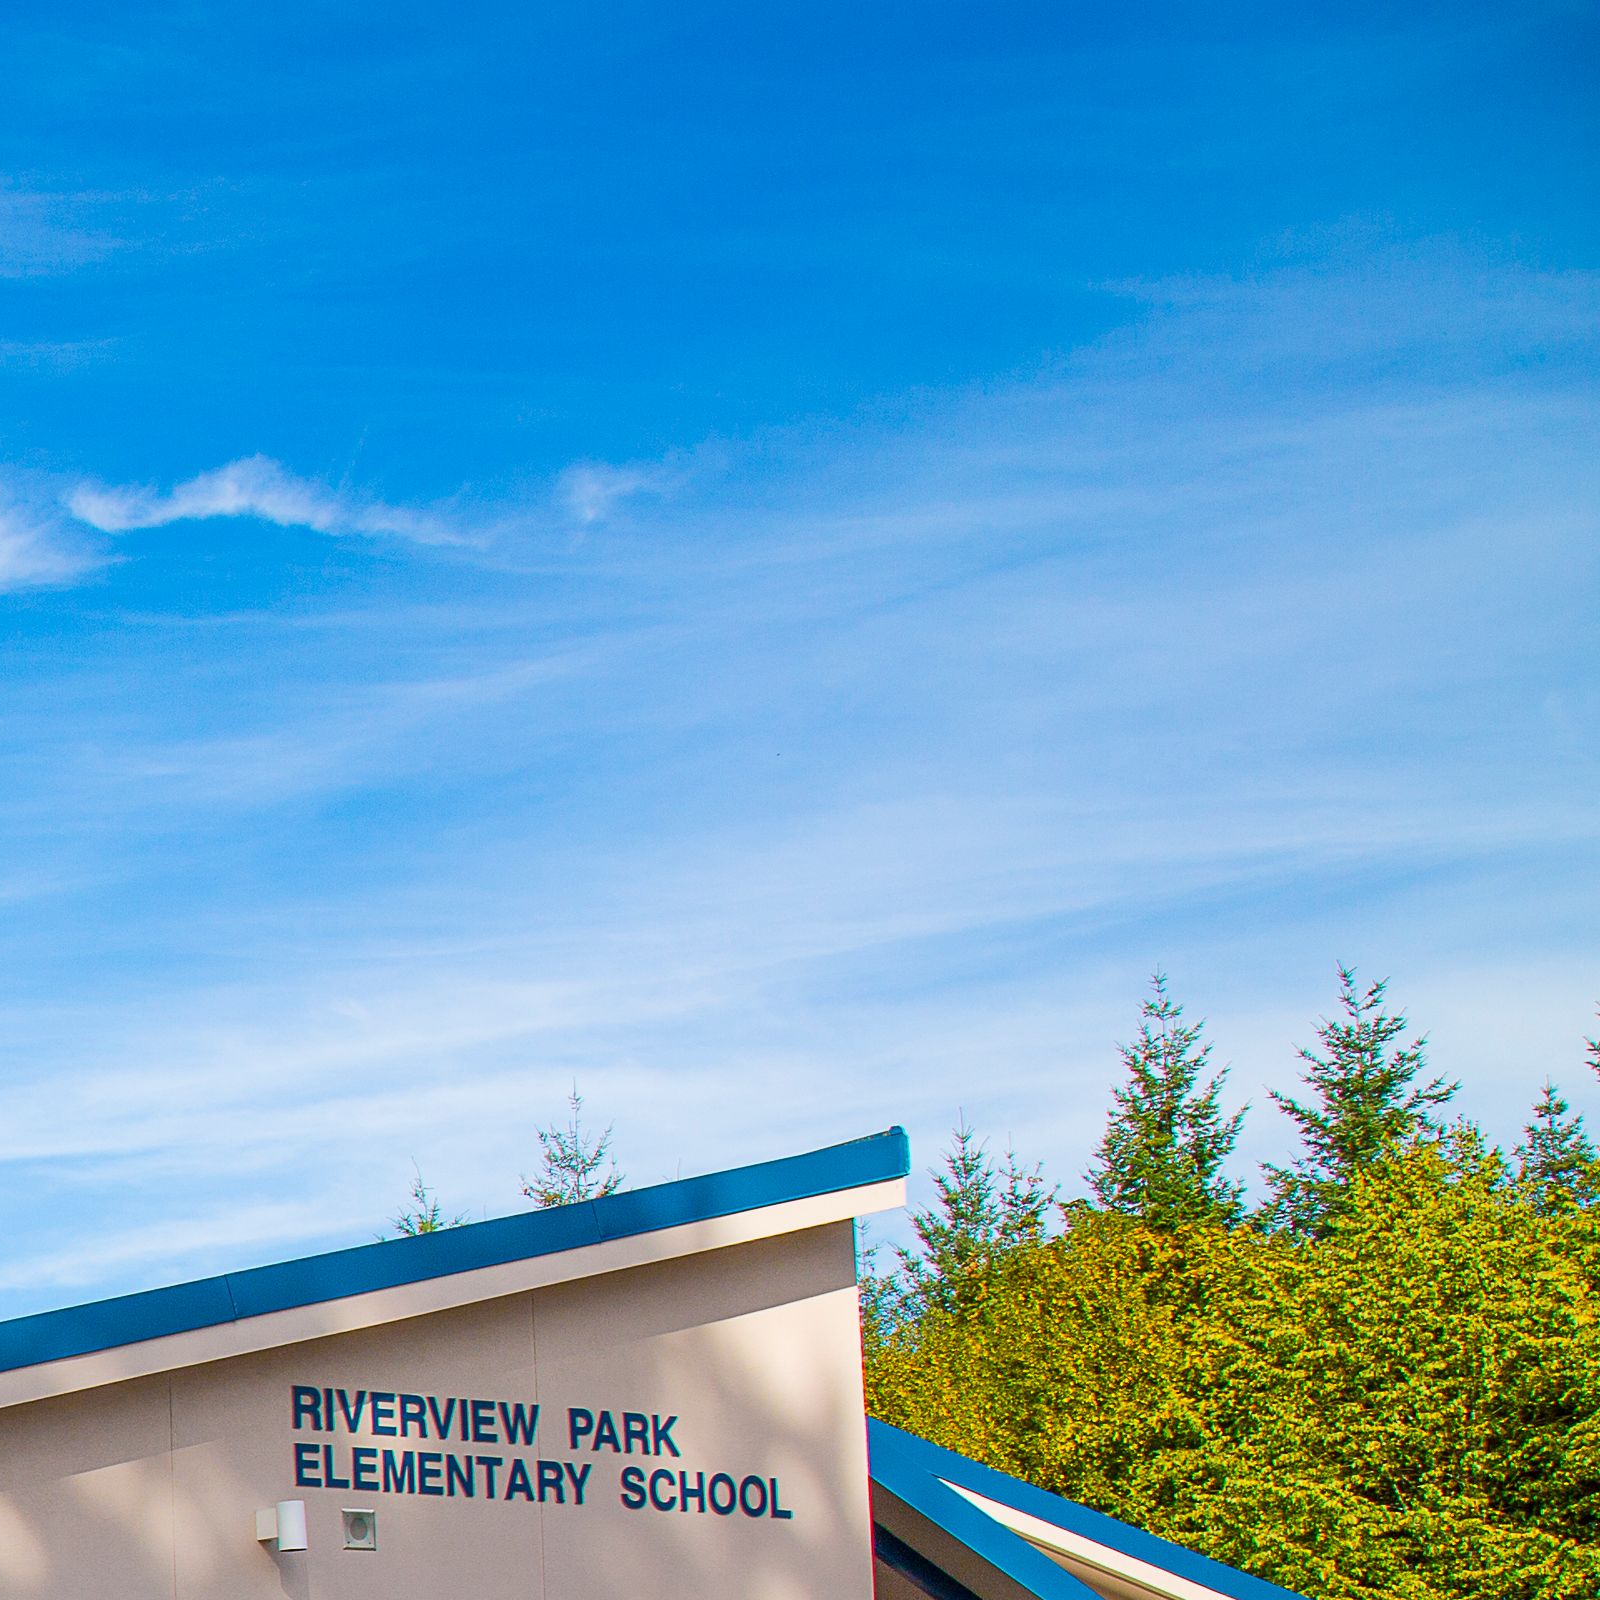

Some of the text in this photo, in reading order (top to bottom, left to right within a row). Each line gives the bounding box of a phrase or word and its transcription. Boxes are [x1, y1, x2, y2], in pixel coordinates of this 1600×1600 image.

[290, 1385, 681, 1458] RIVERVIEW PARK
[293, 1442, 794, 1519] ELEMENTARY SCHOOL
